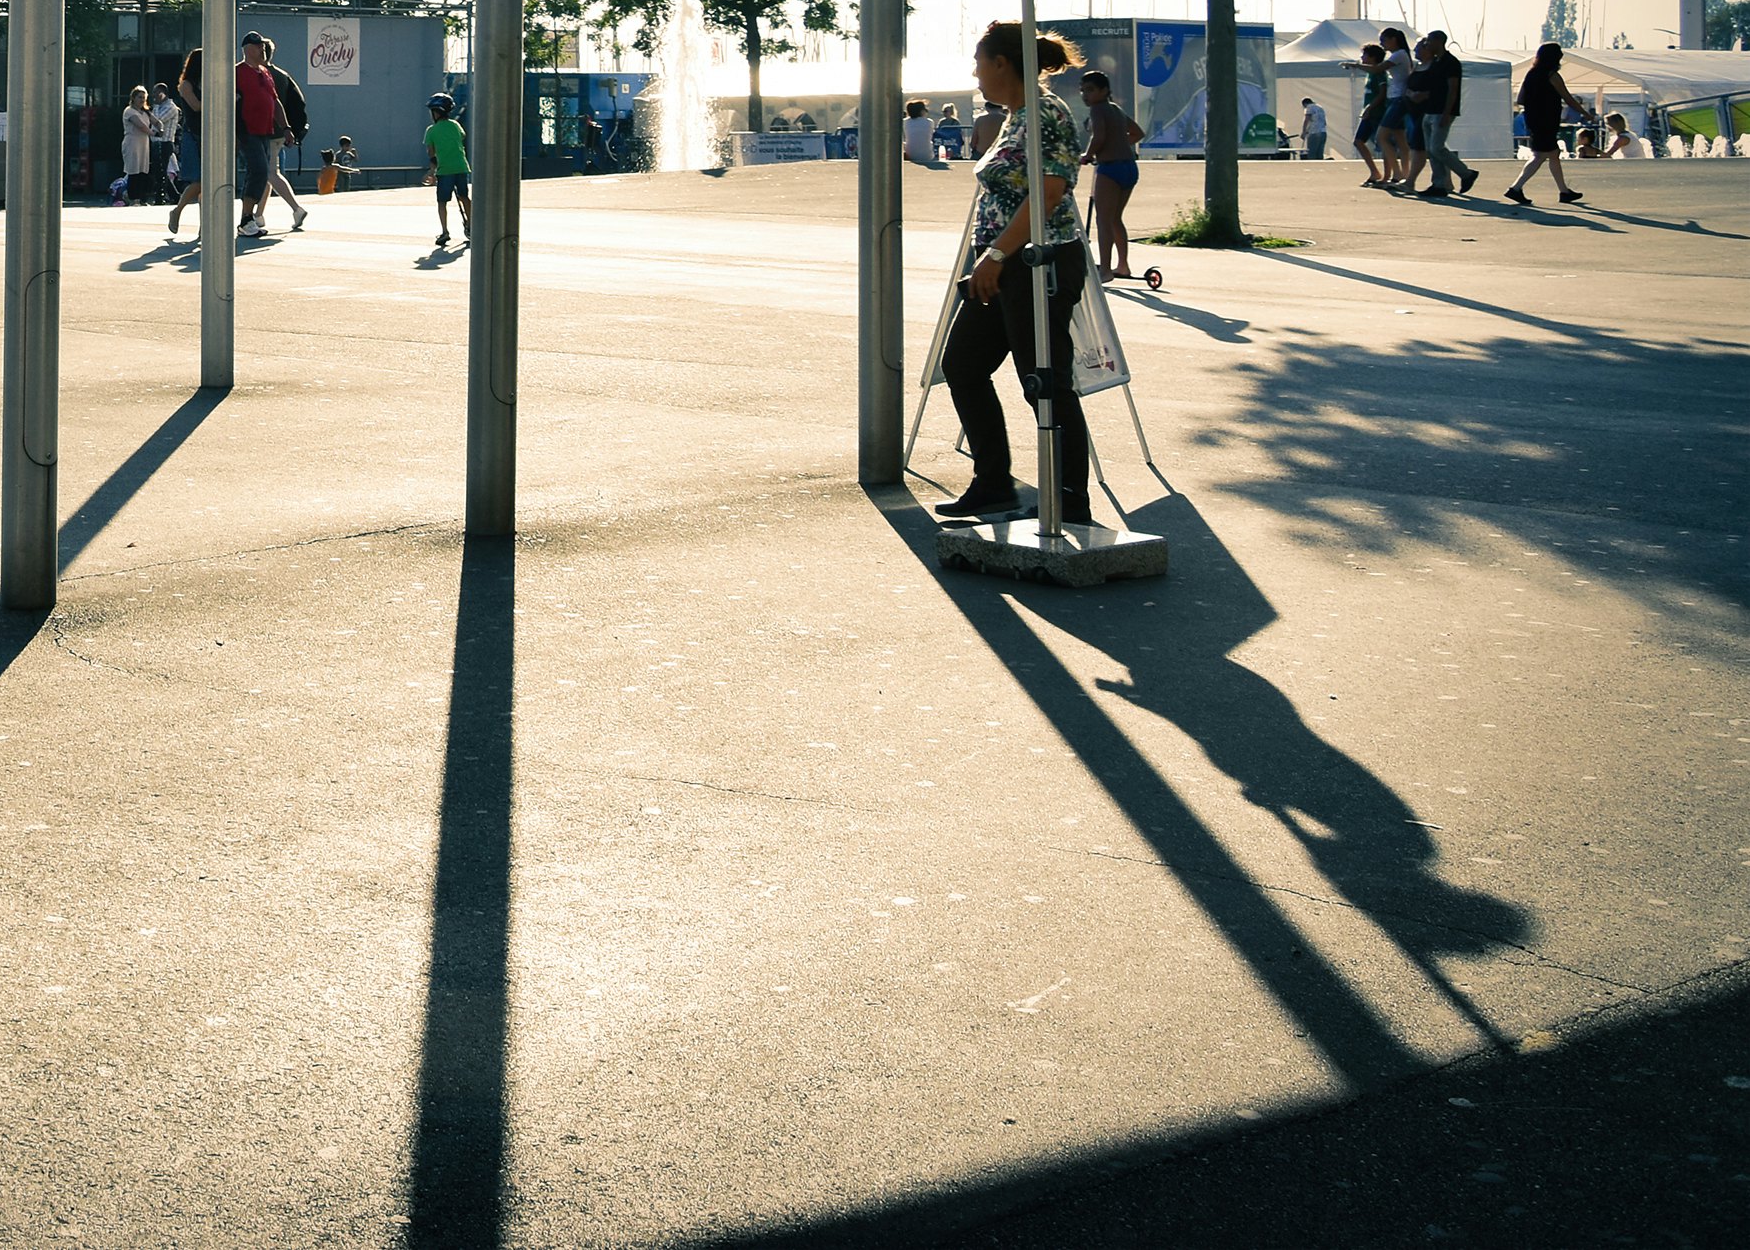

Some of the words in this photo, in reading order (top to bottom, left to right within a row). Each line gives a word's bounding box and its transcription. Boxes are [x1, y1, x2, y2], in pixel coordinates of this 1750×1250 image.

[1091, 28, 1130, 36] RECRUTE
[1151, 32, 1173, 42] Police
[310, 43, 355, 68] Ouchy
